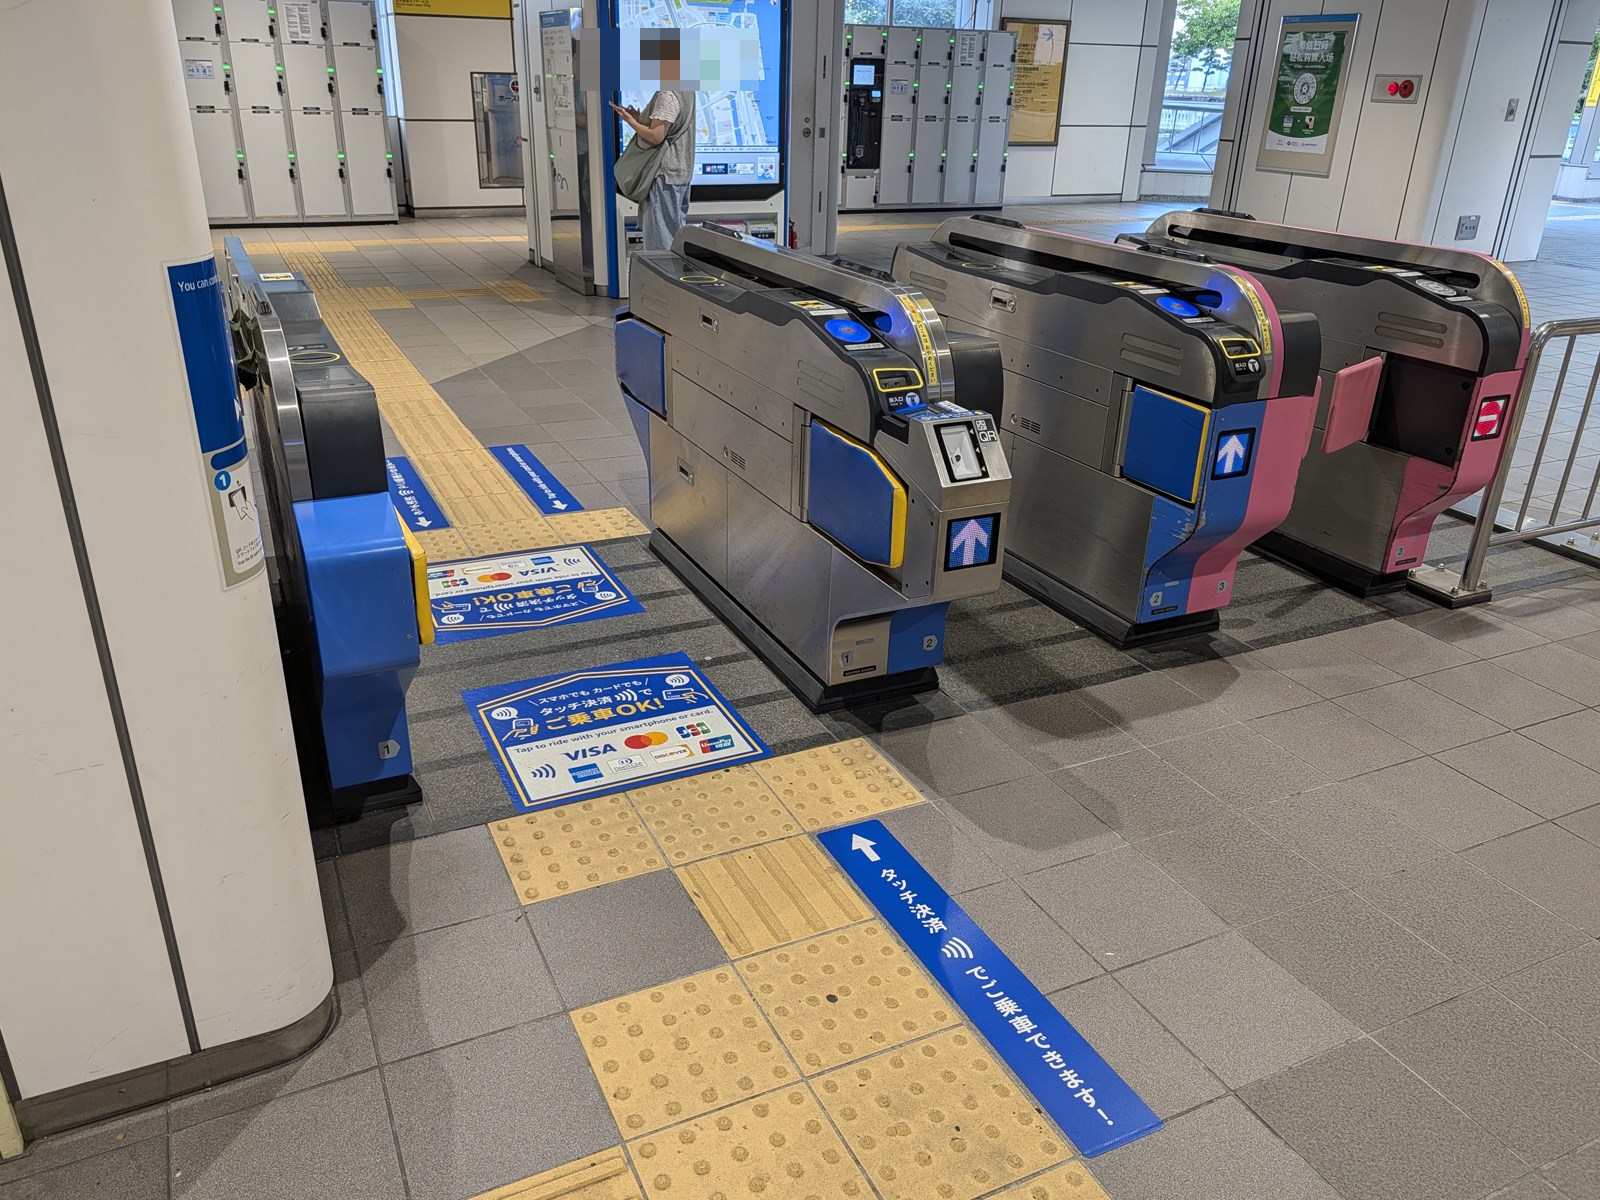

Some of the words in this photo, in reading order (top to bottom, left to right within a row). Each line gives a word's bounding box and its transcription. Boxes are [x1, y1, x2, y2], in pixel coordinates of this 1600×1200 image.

[178, 281, 196, 292] You
[196, 279, 208, 289] can
[979, 430, 997, 442] QR
[219, 474, 226, 487] 1
[518, 566, 559, 576] VISA
[1219, 582, 1225, 590] 3
[472, 584, 572, 606] ご乗車OK!
[516, 593, 577, 607] タッチ決済
[1154, 595, 1159, 603] 2
[535, 601, 579, 612] スマホでも
[486, 609, 532, 619] カードでも
[926, 638, 933, 648] 2
[845, 655, 849, 664] 1
[538, 690, 590, 704] スマホでも
[592, 680, 642, 694] カードでも
[540, 695, 613, 716] タッチ決済
[638, 688, 653, 696] で
[546, 698, 665, 730] ご乗車OK!
[514, 745, 533, 754] Tap
[549, 739, 569, 747] ride
[570, 733, 593, 742] with
[594, 729, 617, 739] your
[619, 716, 677, 732] smartphone
[690, 708, 714, 718] card.
[676, 722, 712, 739] JCB
[384, 745, 390, 754] 1
[560, 743, 618, 761] VISA
[654, 749, 688, 760] DISCOVER
[881, 868, 947, 934] タッチ決済
